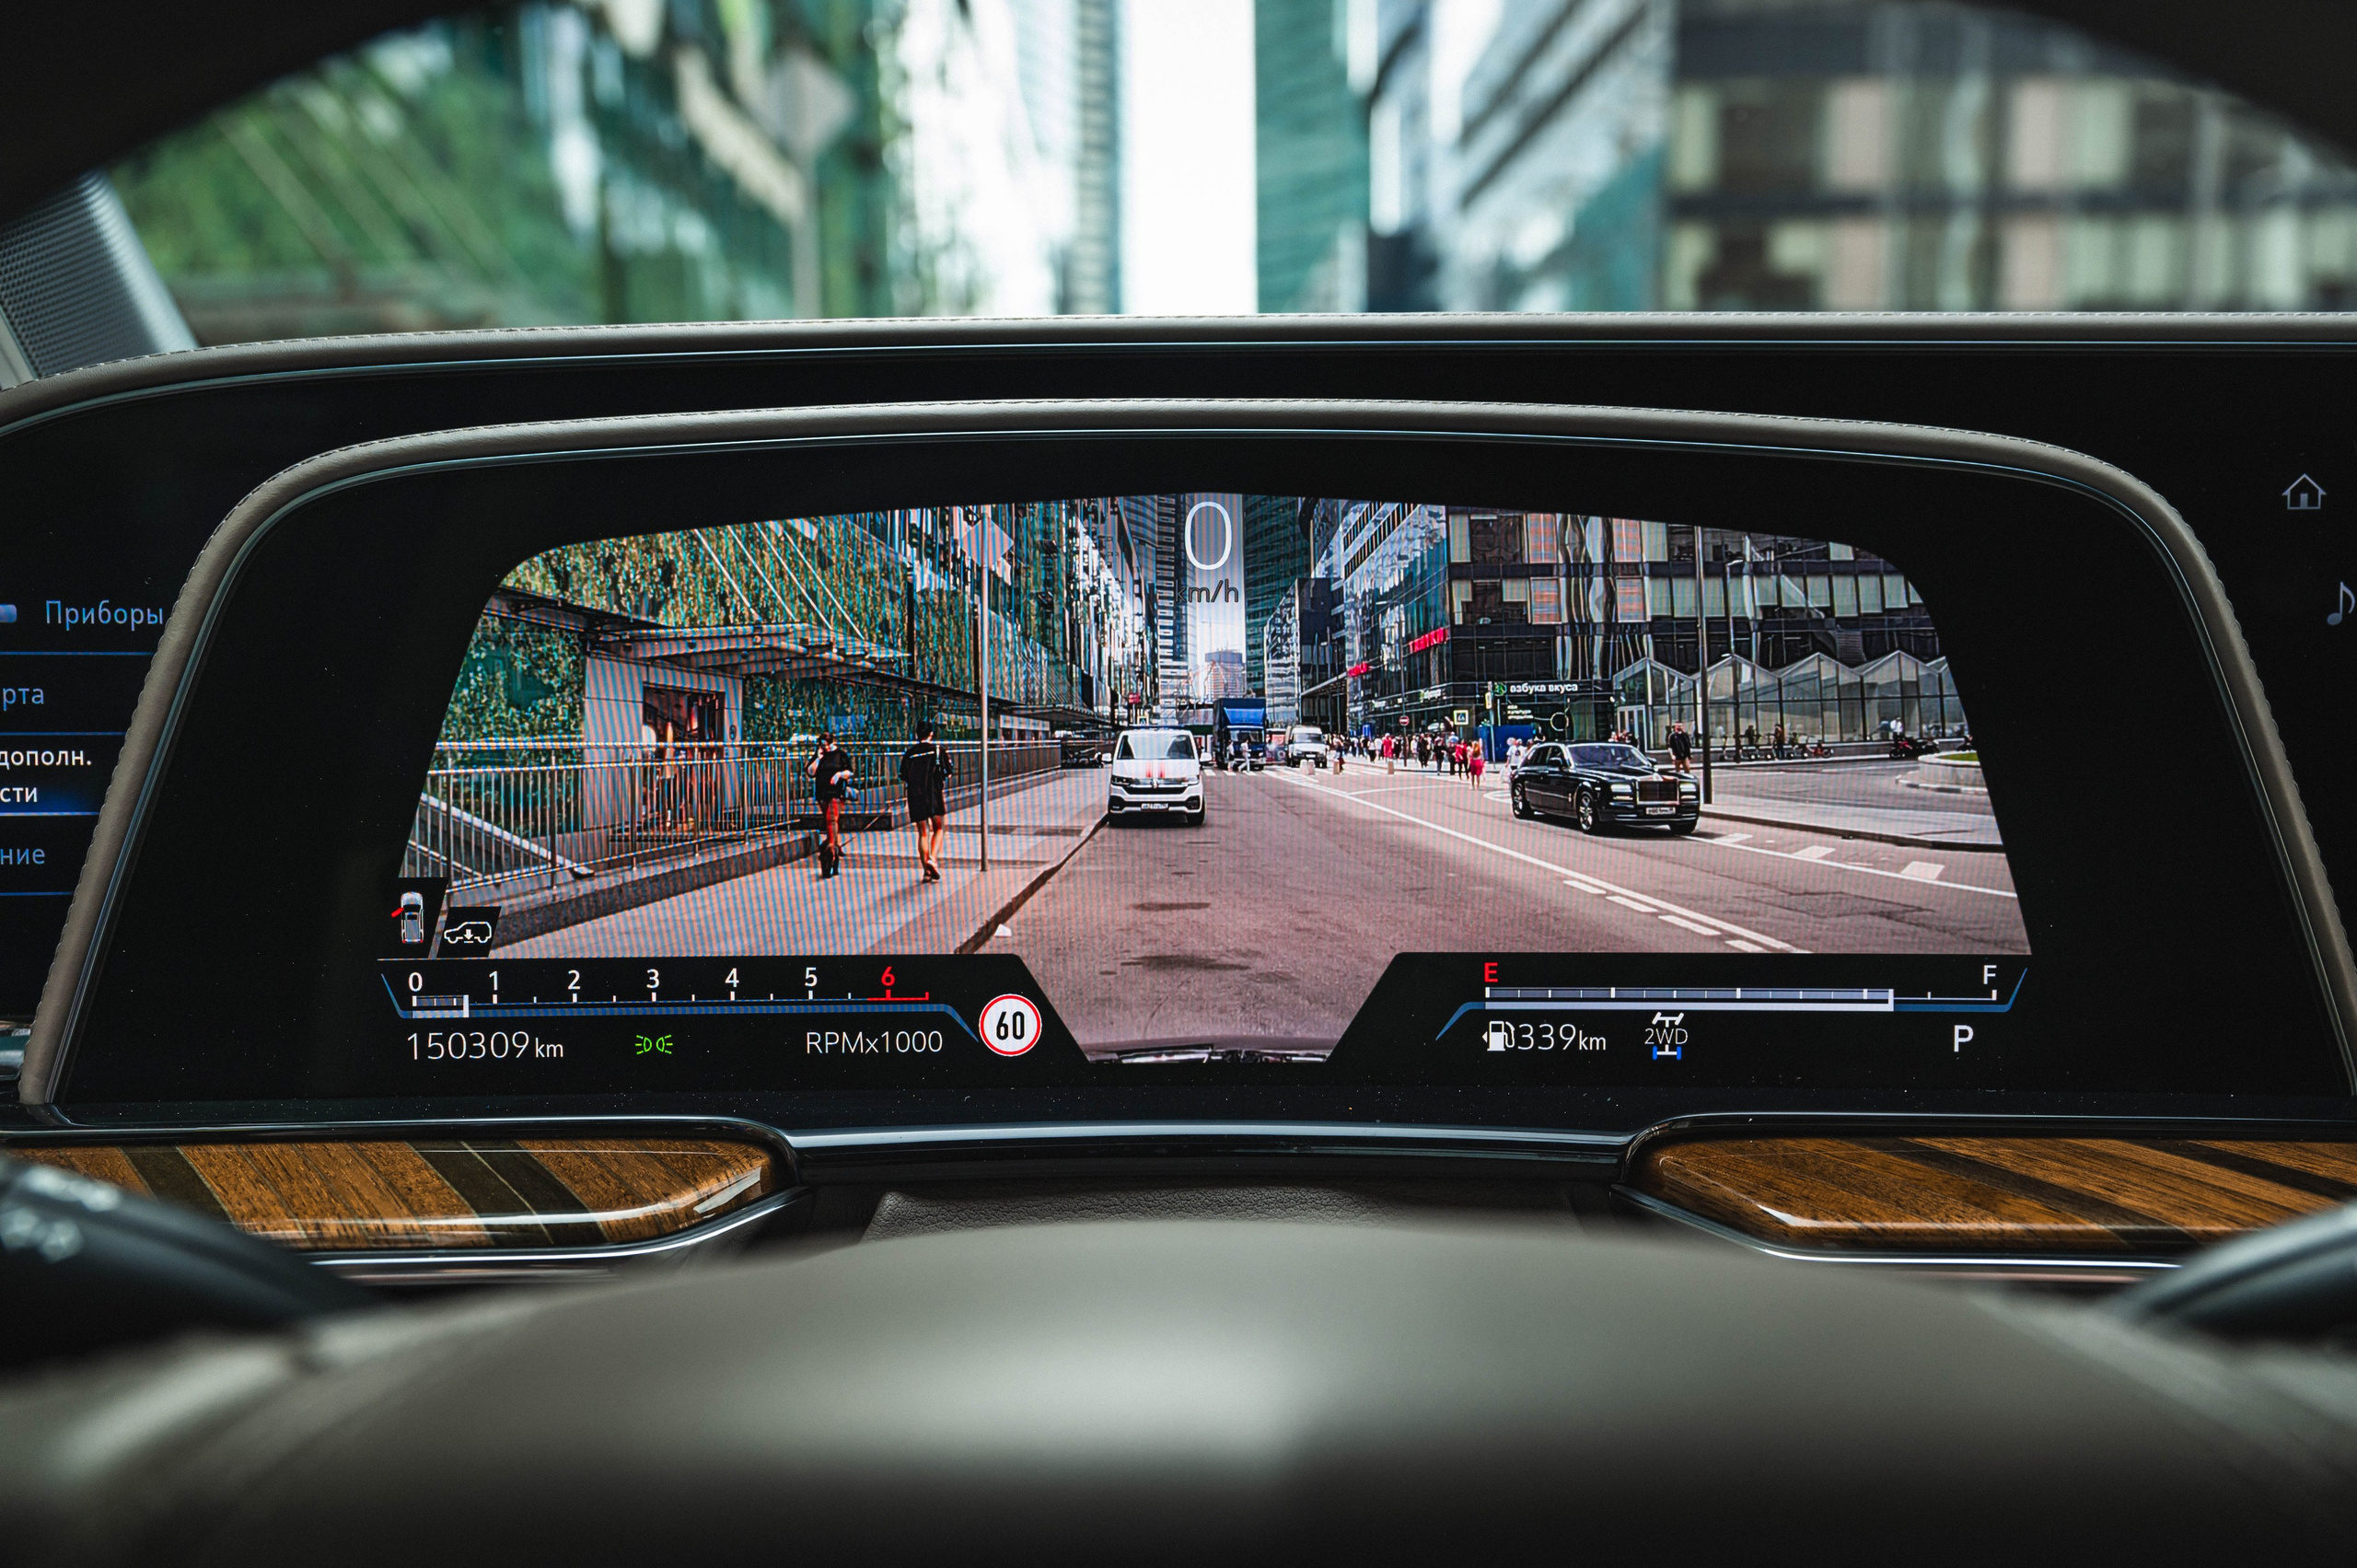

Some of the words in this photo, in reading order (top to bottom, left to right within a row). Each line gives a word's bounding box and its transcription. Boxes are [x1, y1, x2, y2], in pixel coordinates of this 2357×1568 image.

[1184, 501, 1232, 571] 0
[1175, 578, 1239, 603] km/h
[45, 599, 164, 632] Приборы
[1548, 683, 1579, 694] вкуса
[408, 971, 424, 993] 0
[489, 970, 498, 991] 1
[567, 970, 581, 990] 2
[646, 968, 660, 989] 3
[725, 967, 740, 988] 4
[804, 966, 818, 987] 5
[880, 966, 896, 987] 6
[1483, 961, 1499, 983] E
[1983, 964, 1997, 985] F
[996, 1011, 1025, 1040] 60
[1644, 1028, 1689, 1045] 2WD
[1954, 1024, 1975, 1052] P
[806, 1030, 944, 1055] RPMx1000
